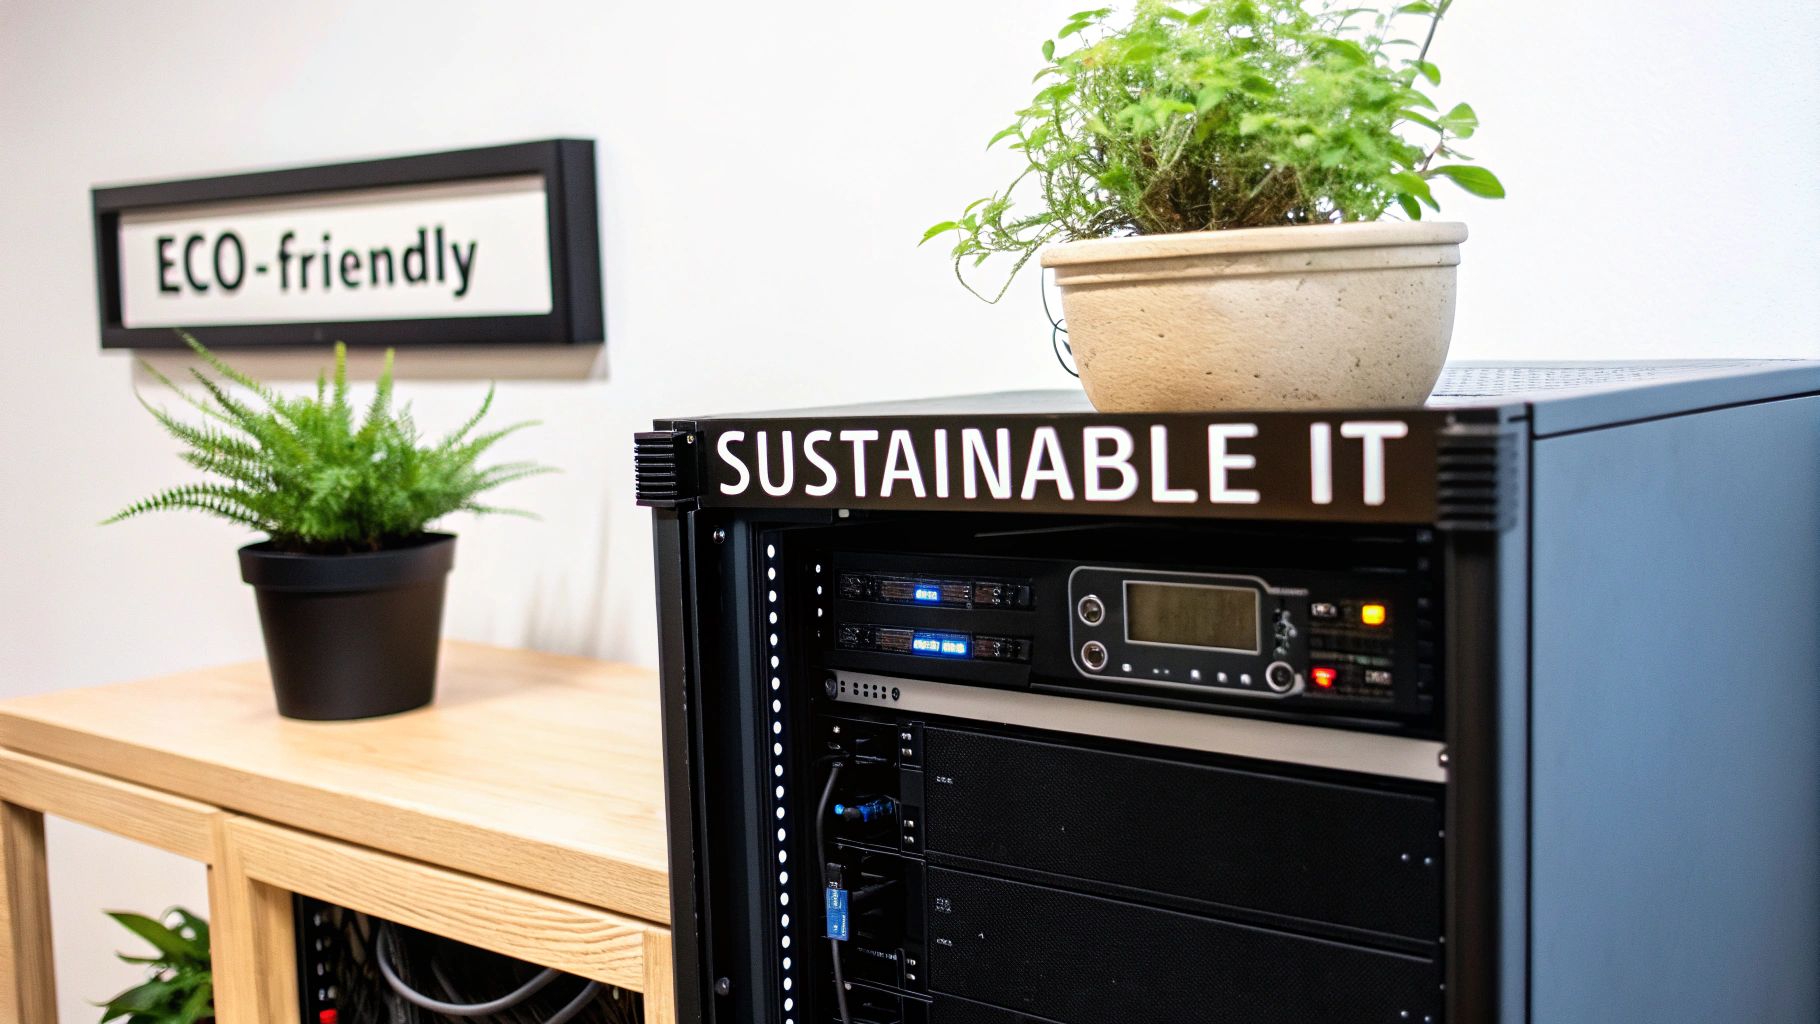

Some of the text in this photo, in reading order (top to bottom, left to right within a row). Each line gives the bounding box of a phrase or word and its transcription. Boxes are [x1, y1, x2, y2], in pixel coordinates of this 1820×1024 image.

[156, 225, 478, 298] ECO-friendly
[716, 420, 1408, 506] SUSTAINABLE IT
